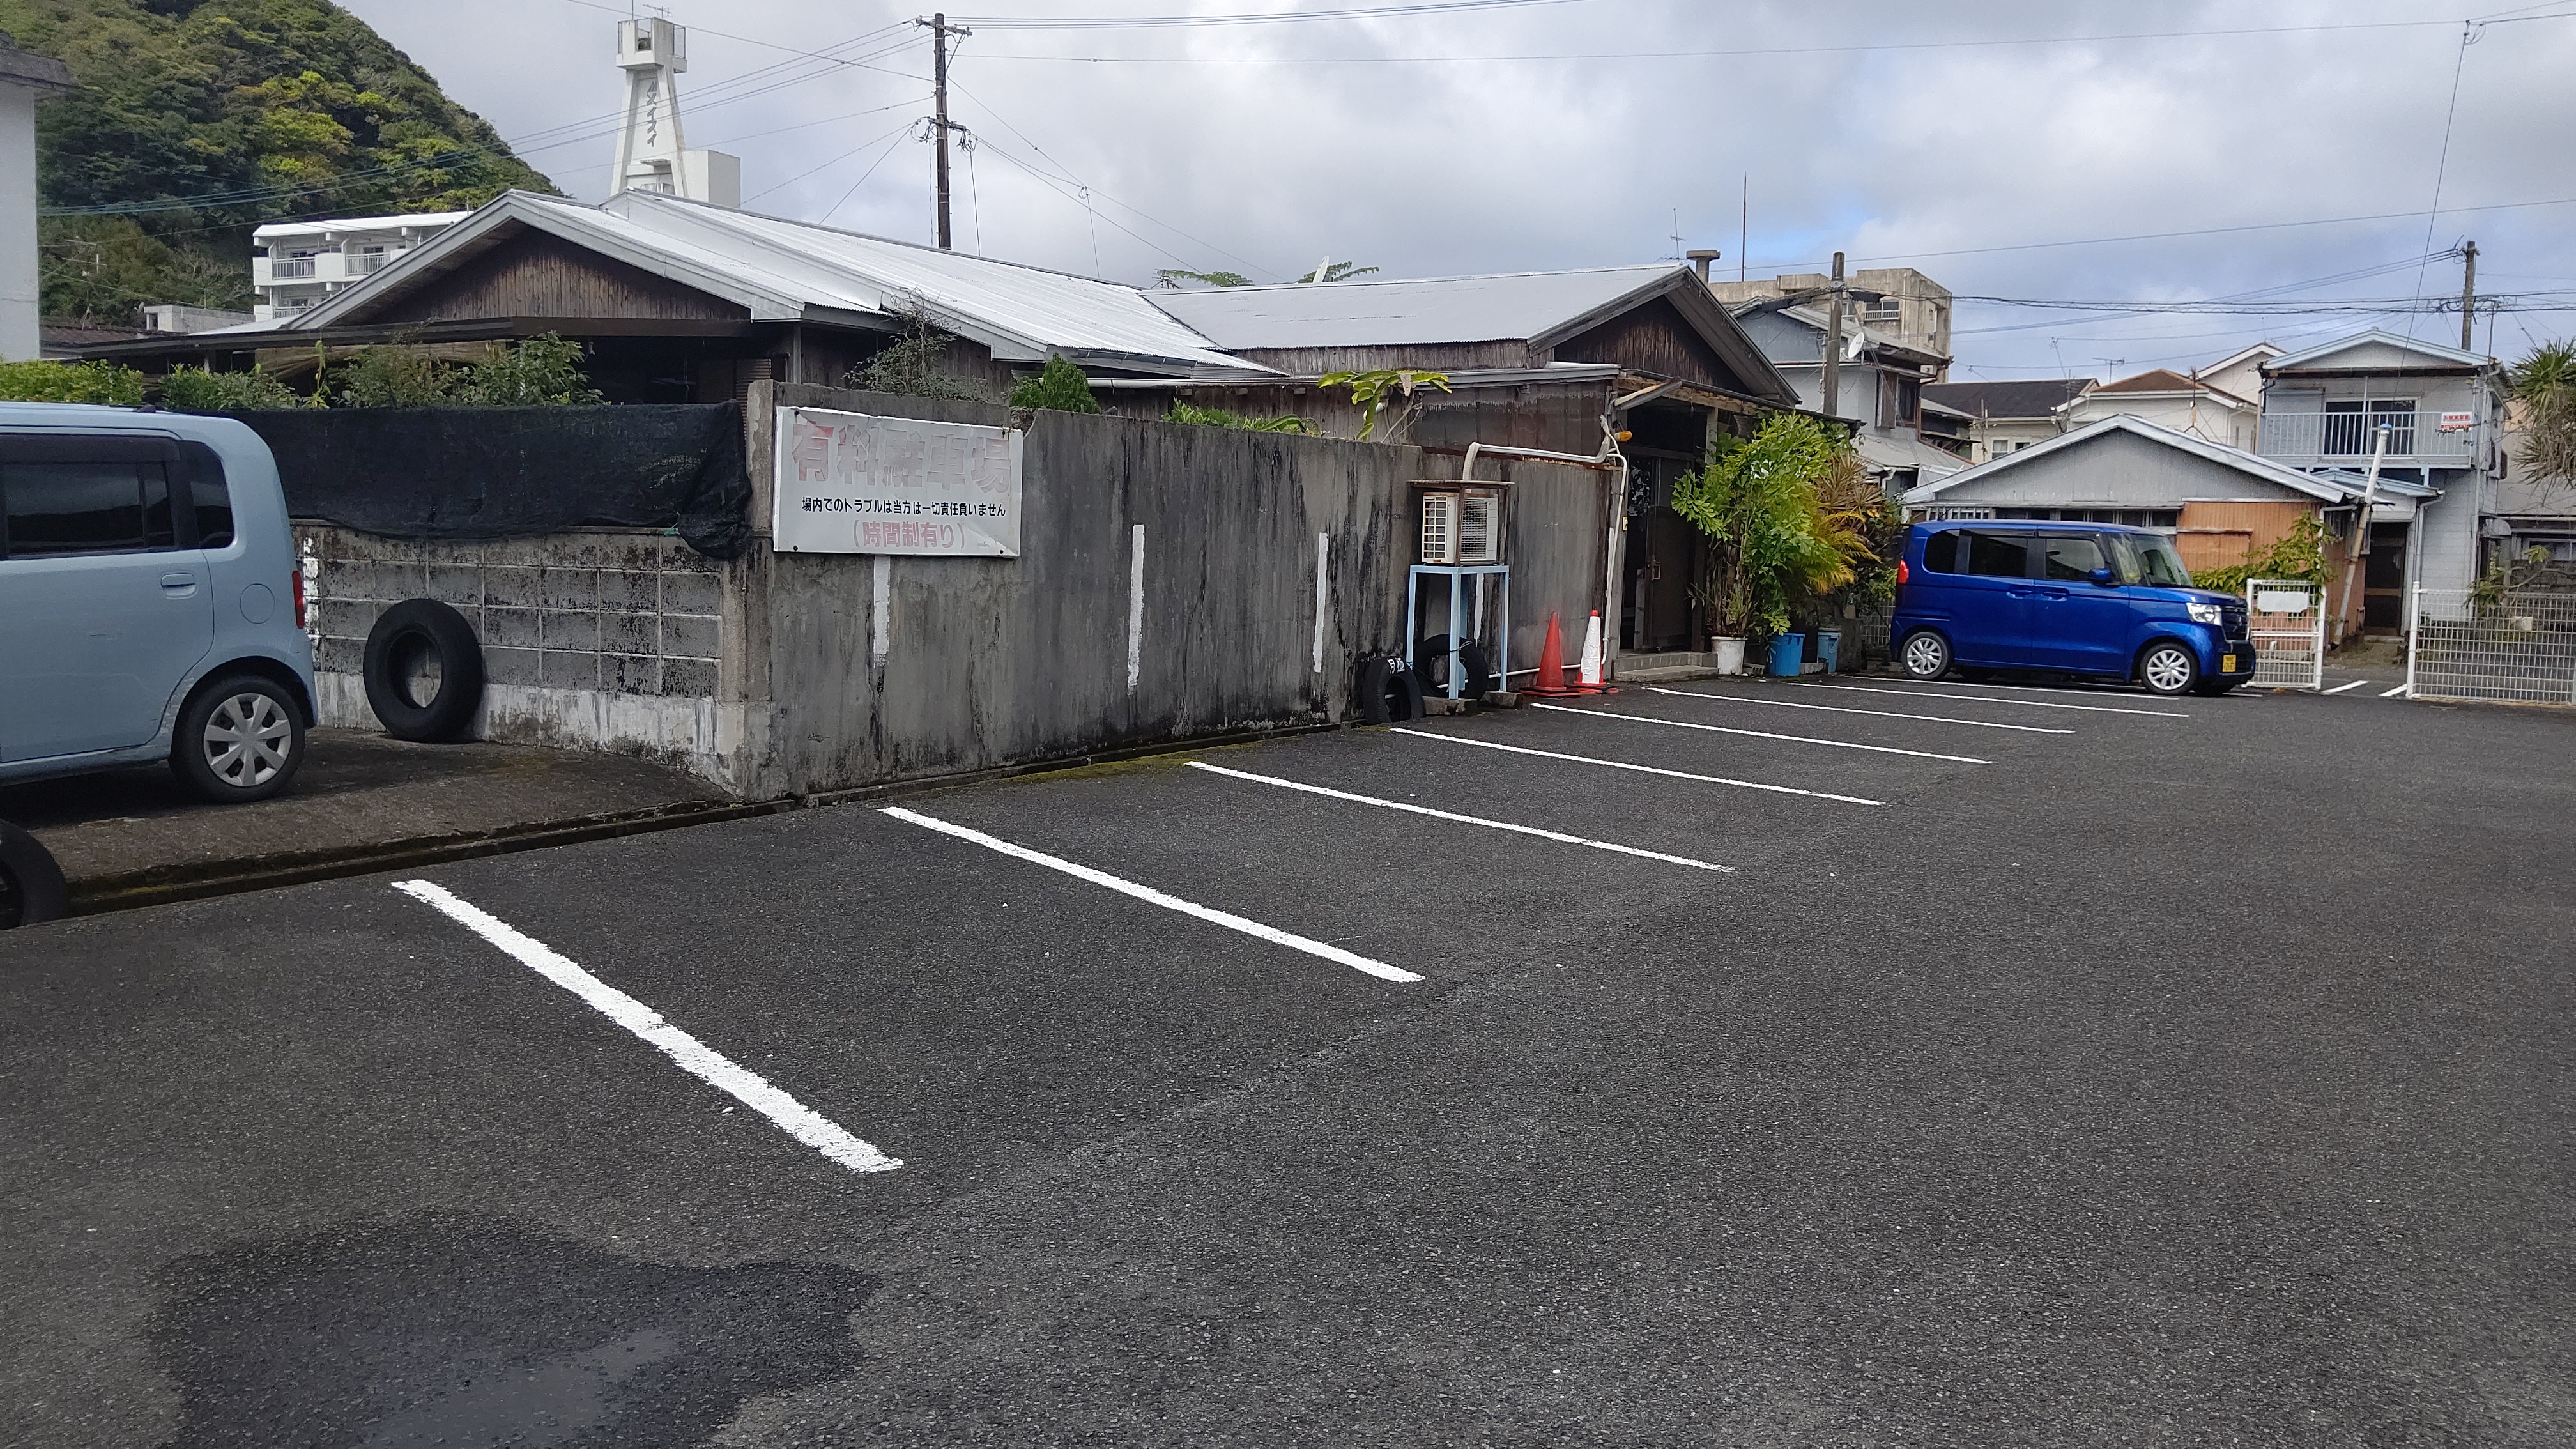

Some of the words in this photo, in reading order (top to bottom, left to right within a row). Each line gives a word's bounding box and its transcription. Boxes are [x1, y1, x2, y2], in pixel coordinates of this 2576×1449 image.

[792, 420, 1011, 493] 有料駐車場
[802, 496, 1006, 516] 場内でのトラブルは当方は一切責任負いません
